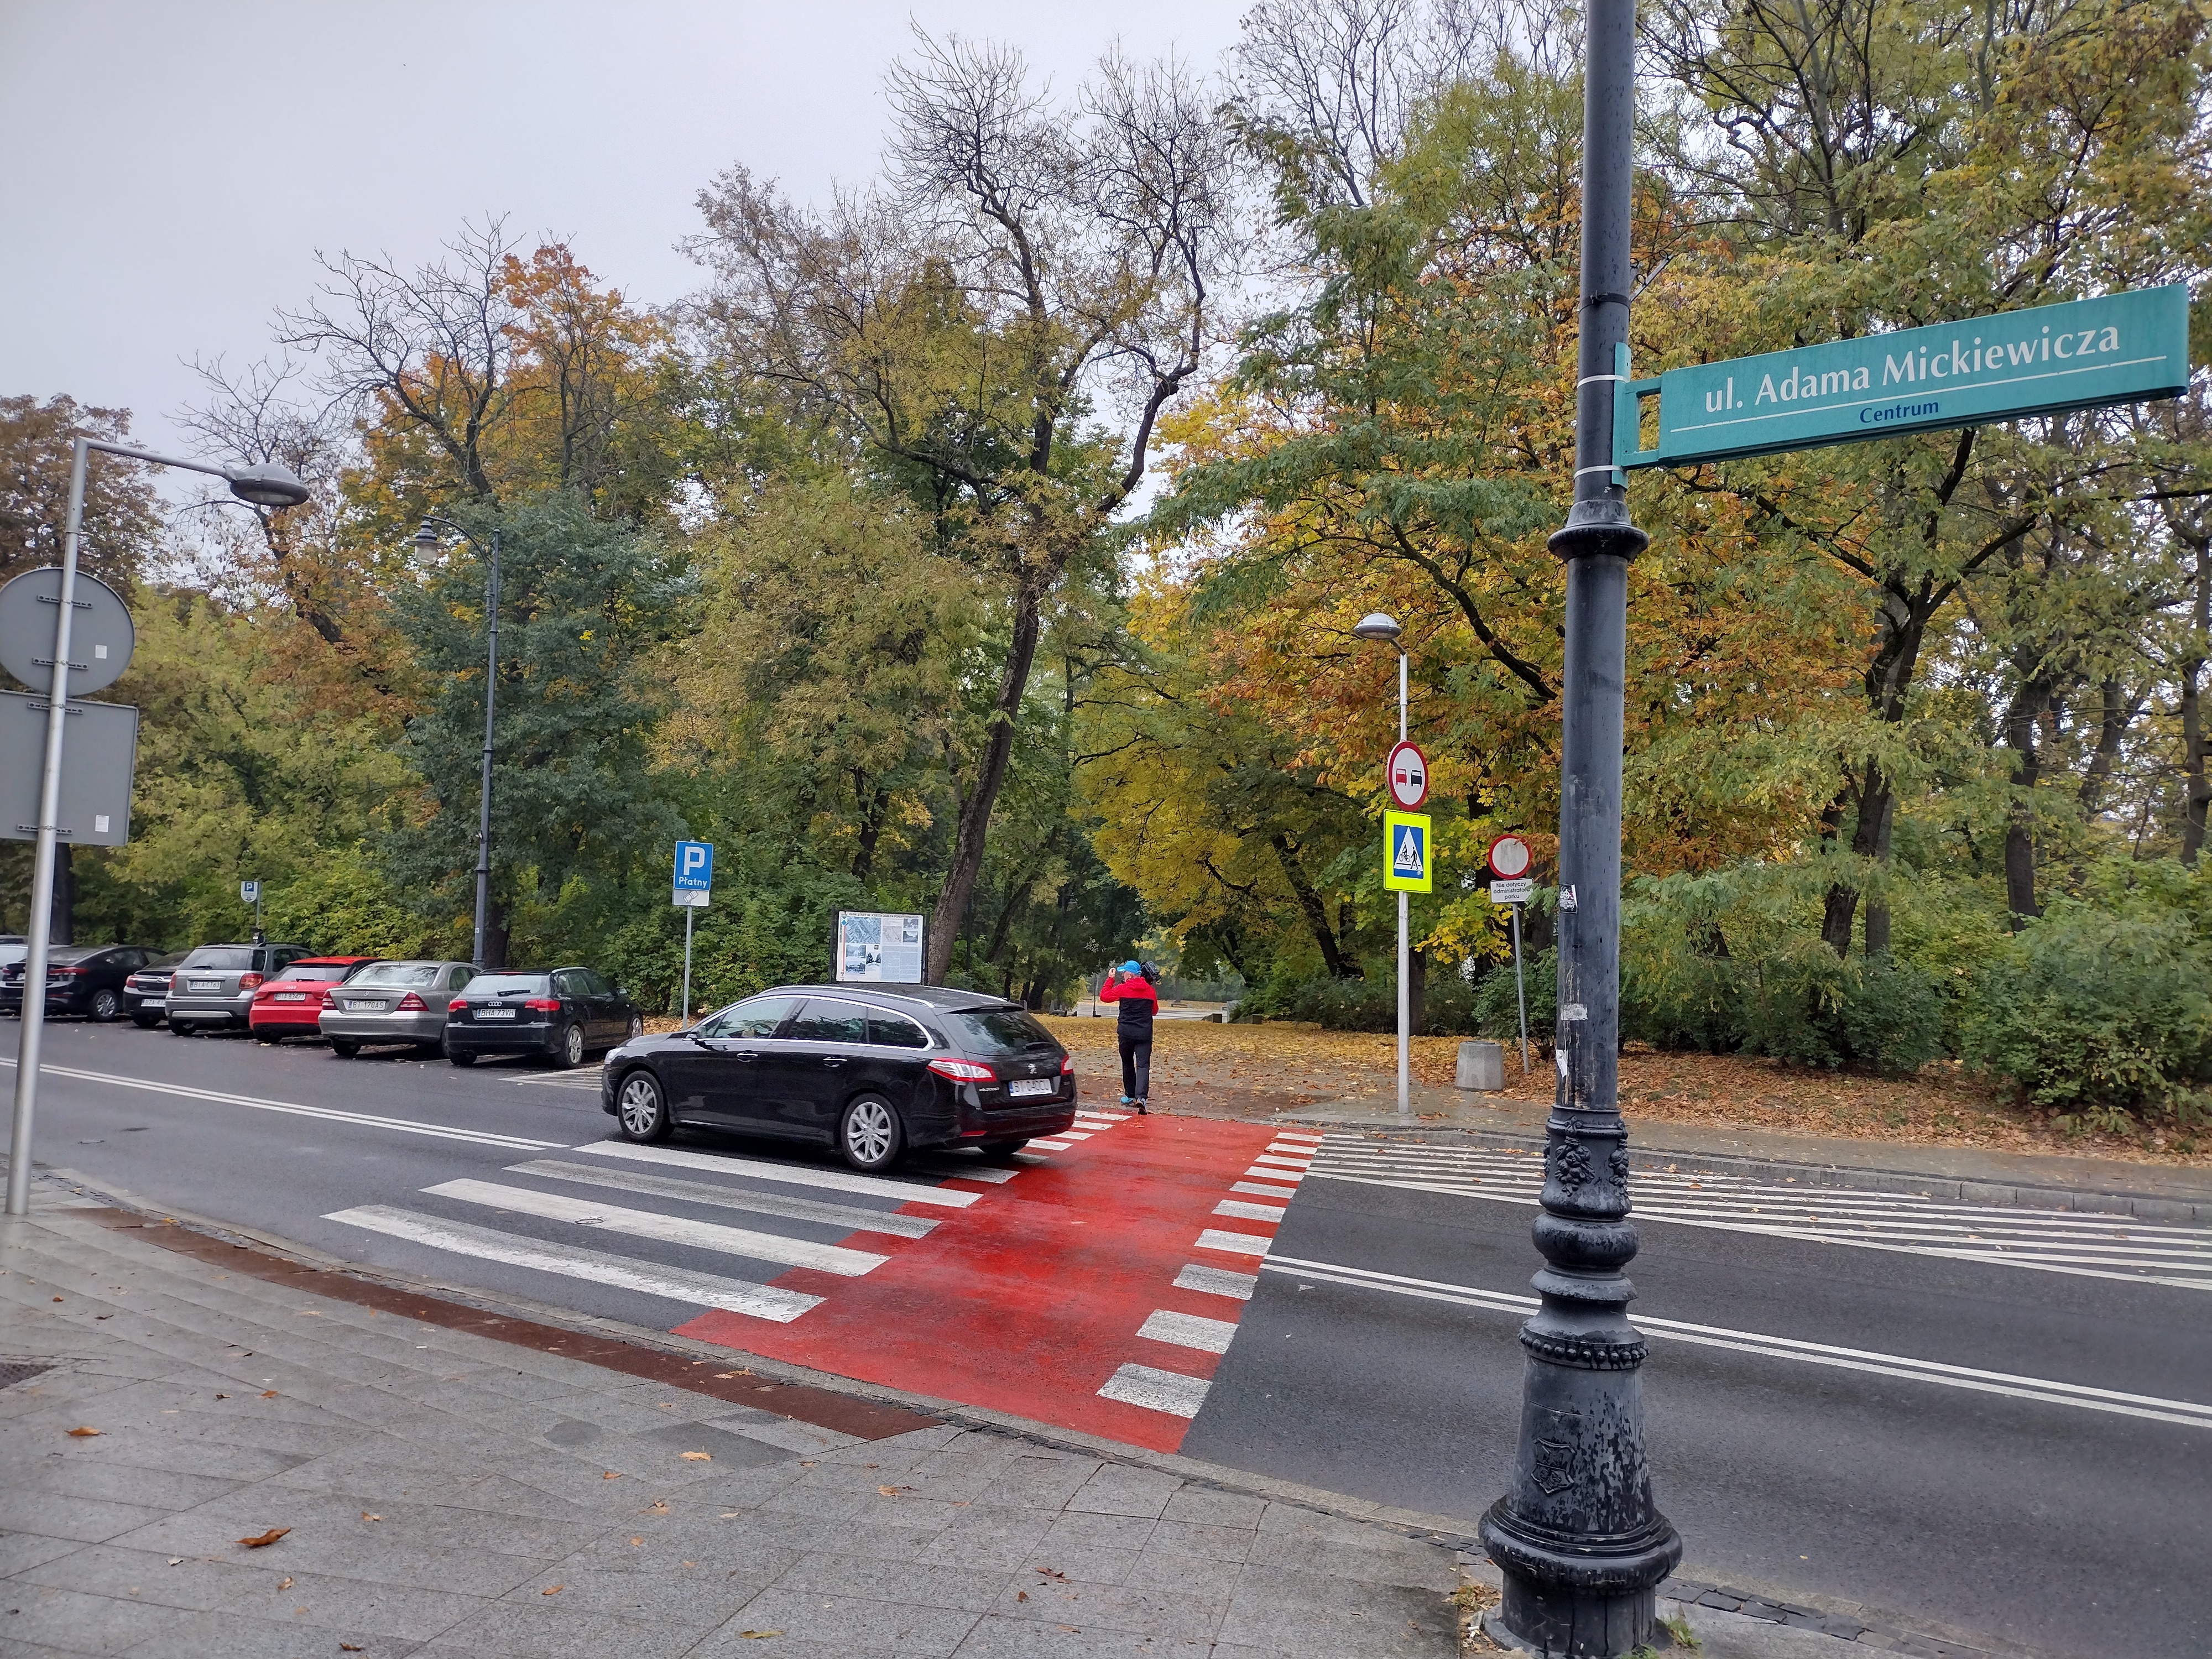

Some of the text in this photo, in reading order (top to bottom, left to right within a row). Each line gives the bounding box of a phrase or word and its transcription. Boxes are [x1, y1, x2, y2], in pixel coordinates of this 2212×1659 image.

[1705, 325, 2120, 413] ul. Adama Mickiewicza
[1860, 401, 1939, 424] Centrum
[683, 846, 705, 875] P
[246, 883, 253, 891] P
[678, 876, 708, 889] Płatny
